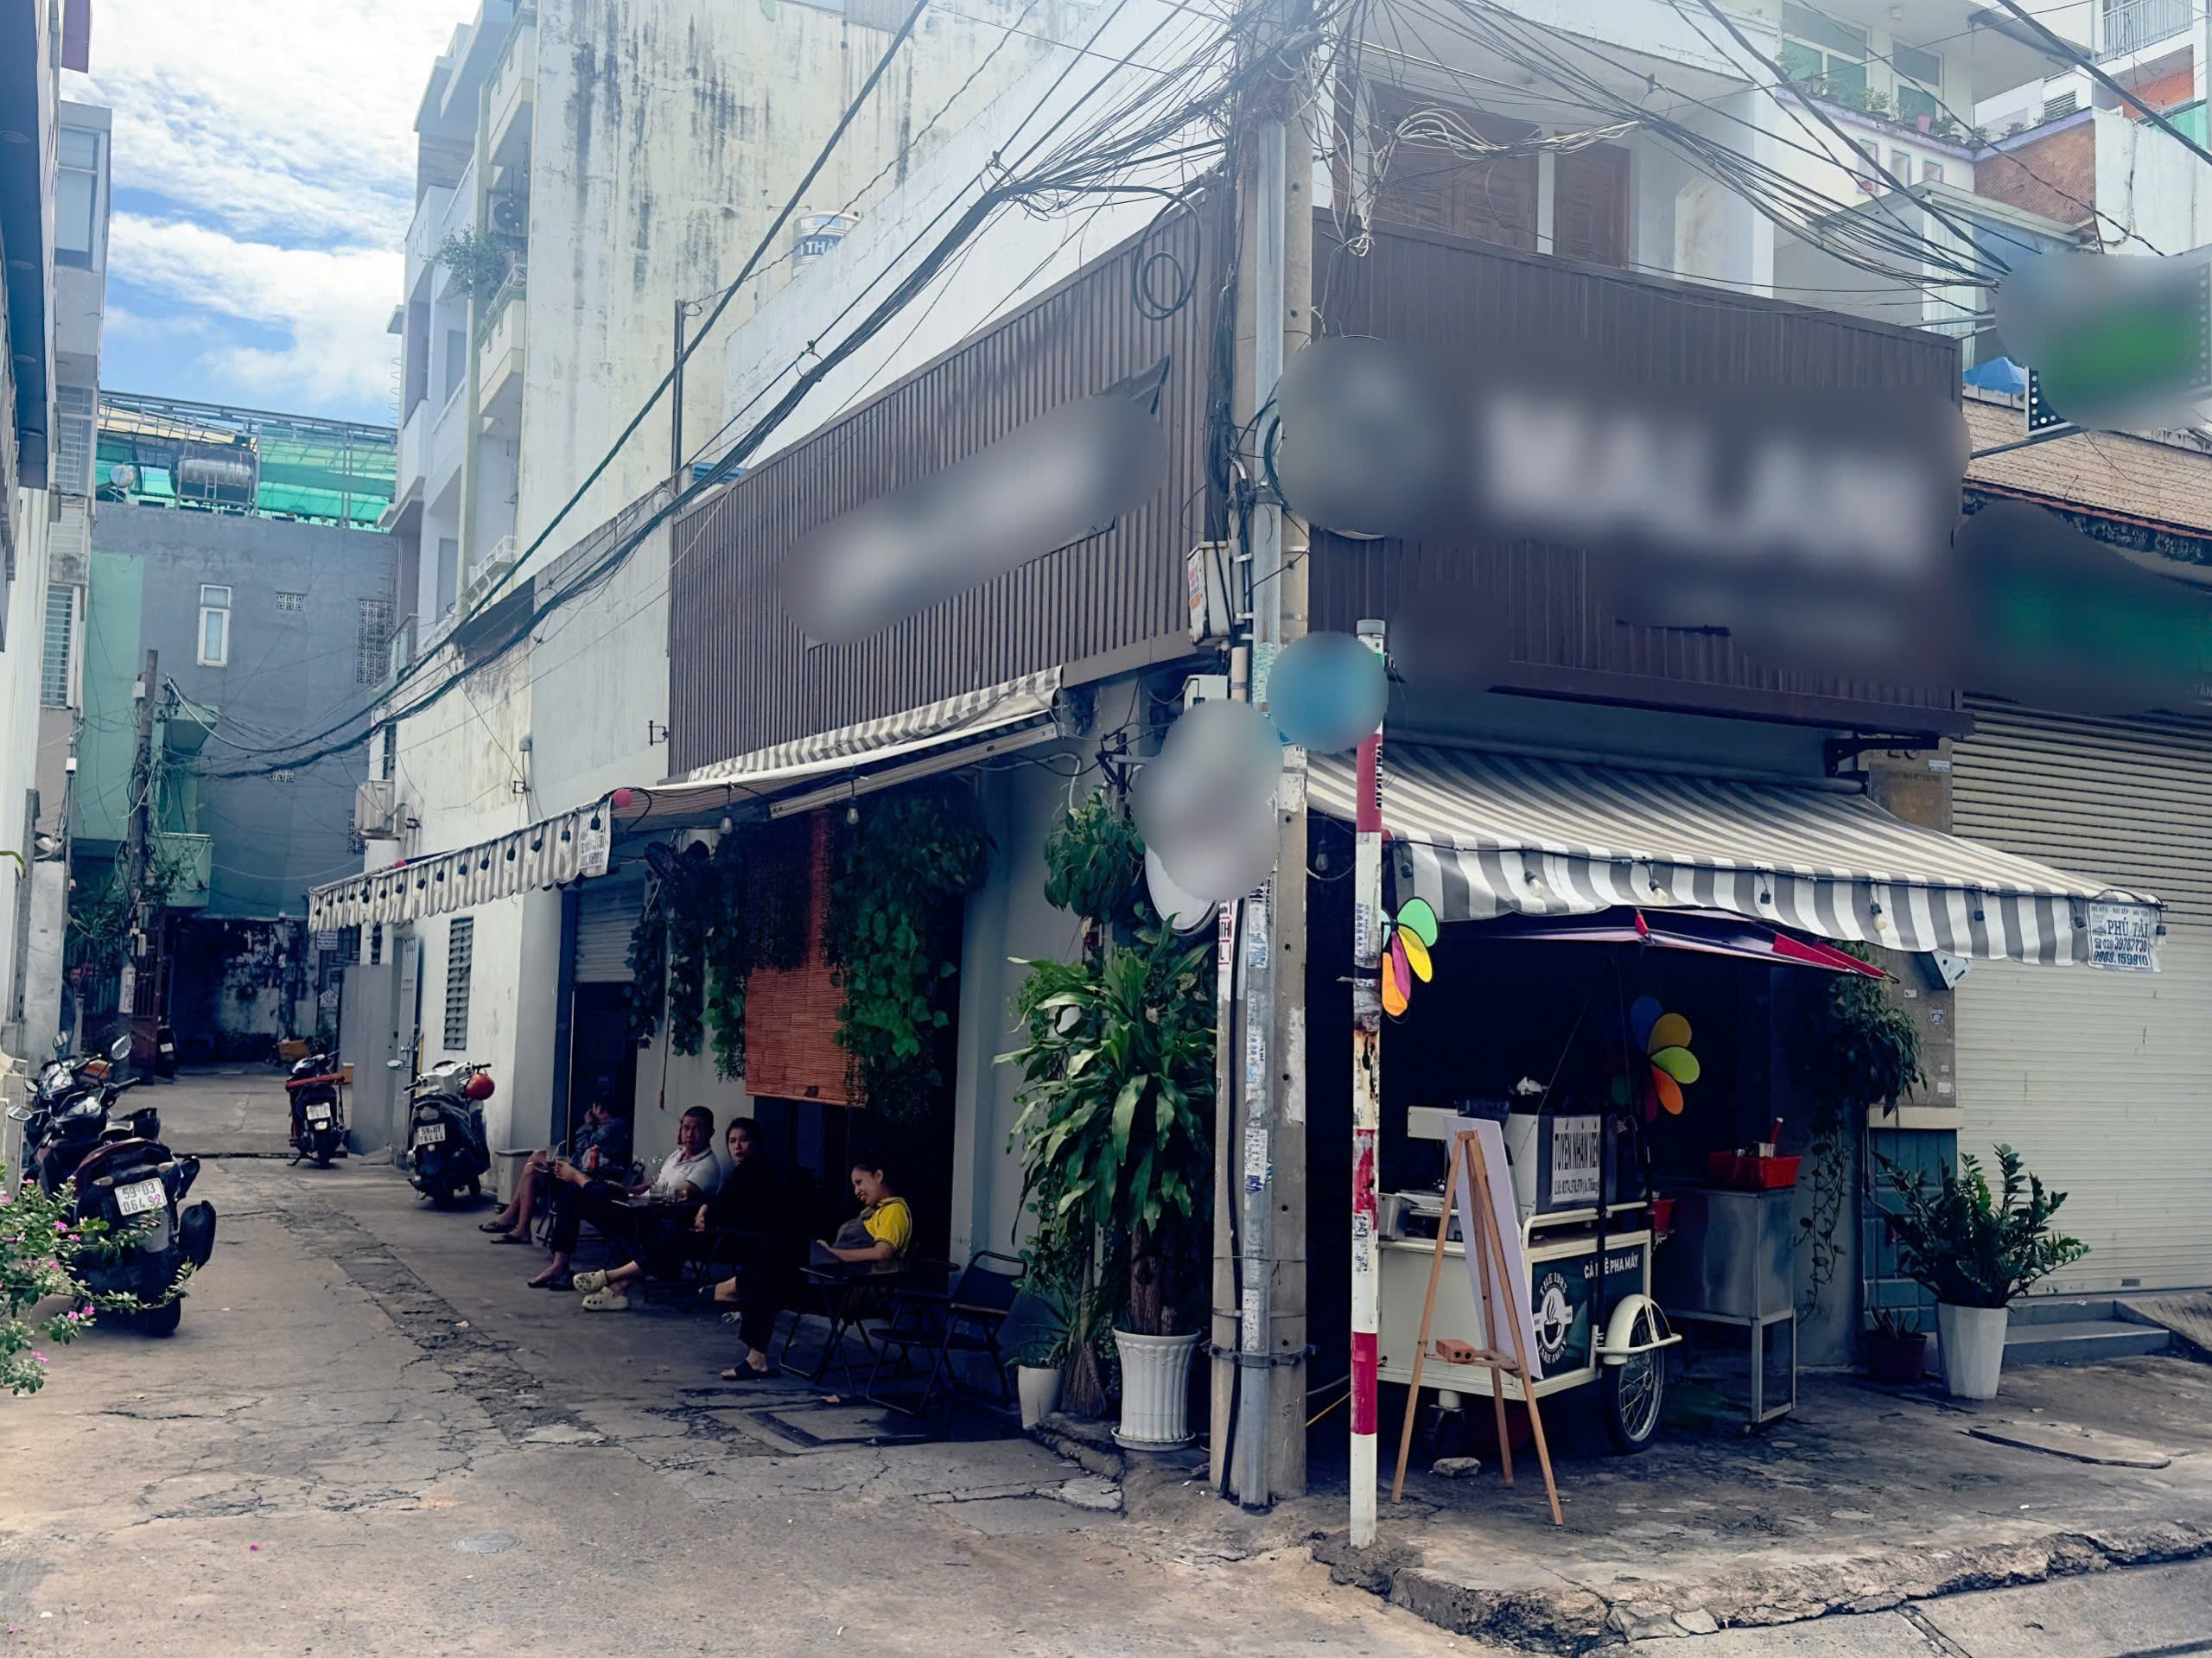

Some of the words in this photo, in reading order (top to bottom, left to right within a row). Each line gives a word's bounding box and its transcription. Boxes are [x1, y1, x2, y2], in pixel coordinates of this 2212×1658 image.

[2107, 916, 2128, 936] PHÚ
[2133, 918, 2149, 938] TÀI
[1584, 1261, 1594, 1279] CÀ
[1610, 1258, 1624, 1274] PHA
[1624, 1252, 1638, 1270] MÁY
[1540, 1273, 1553, 1296] THE
[1538, 1341, 1551, 1364] TAKE
